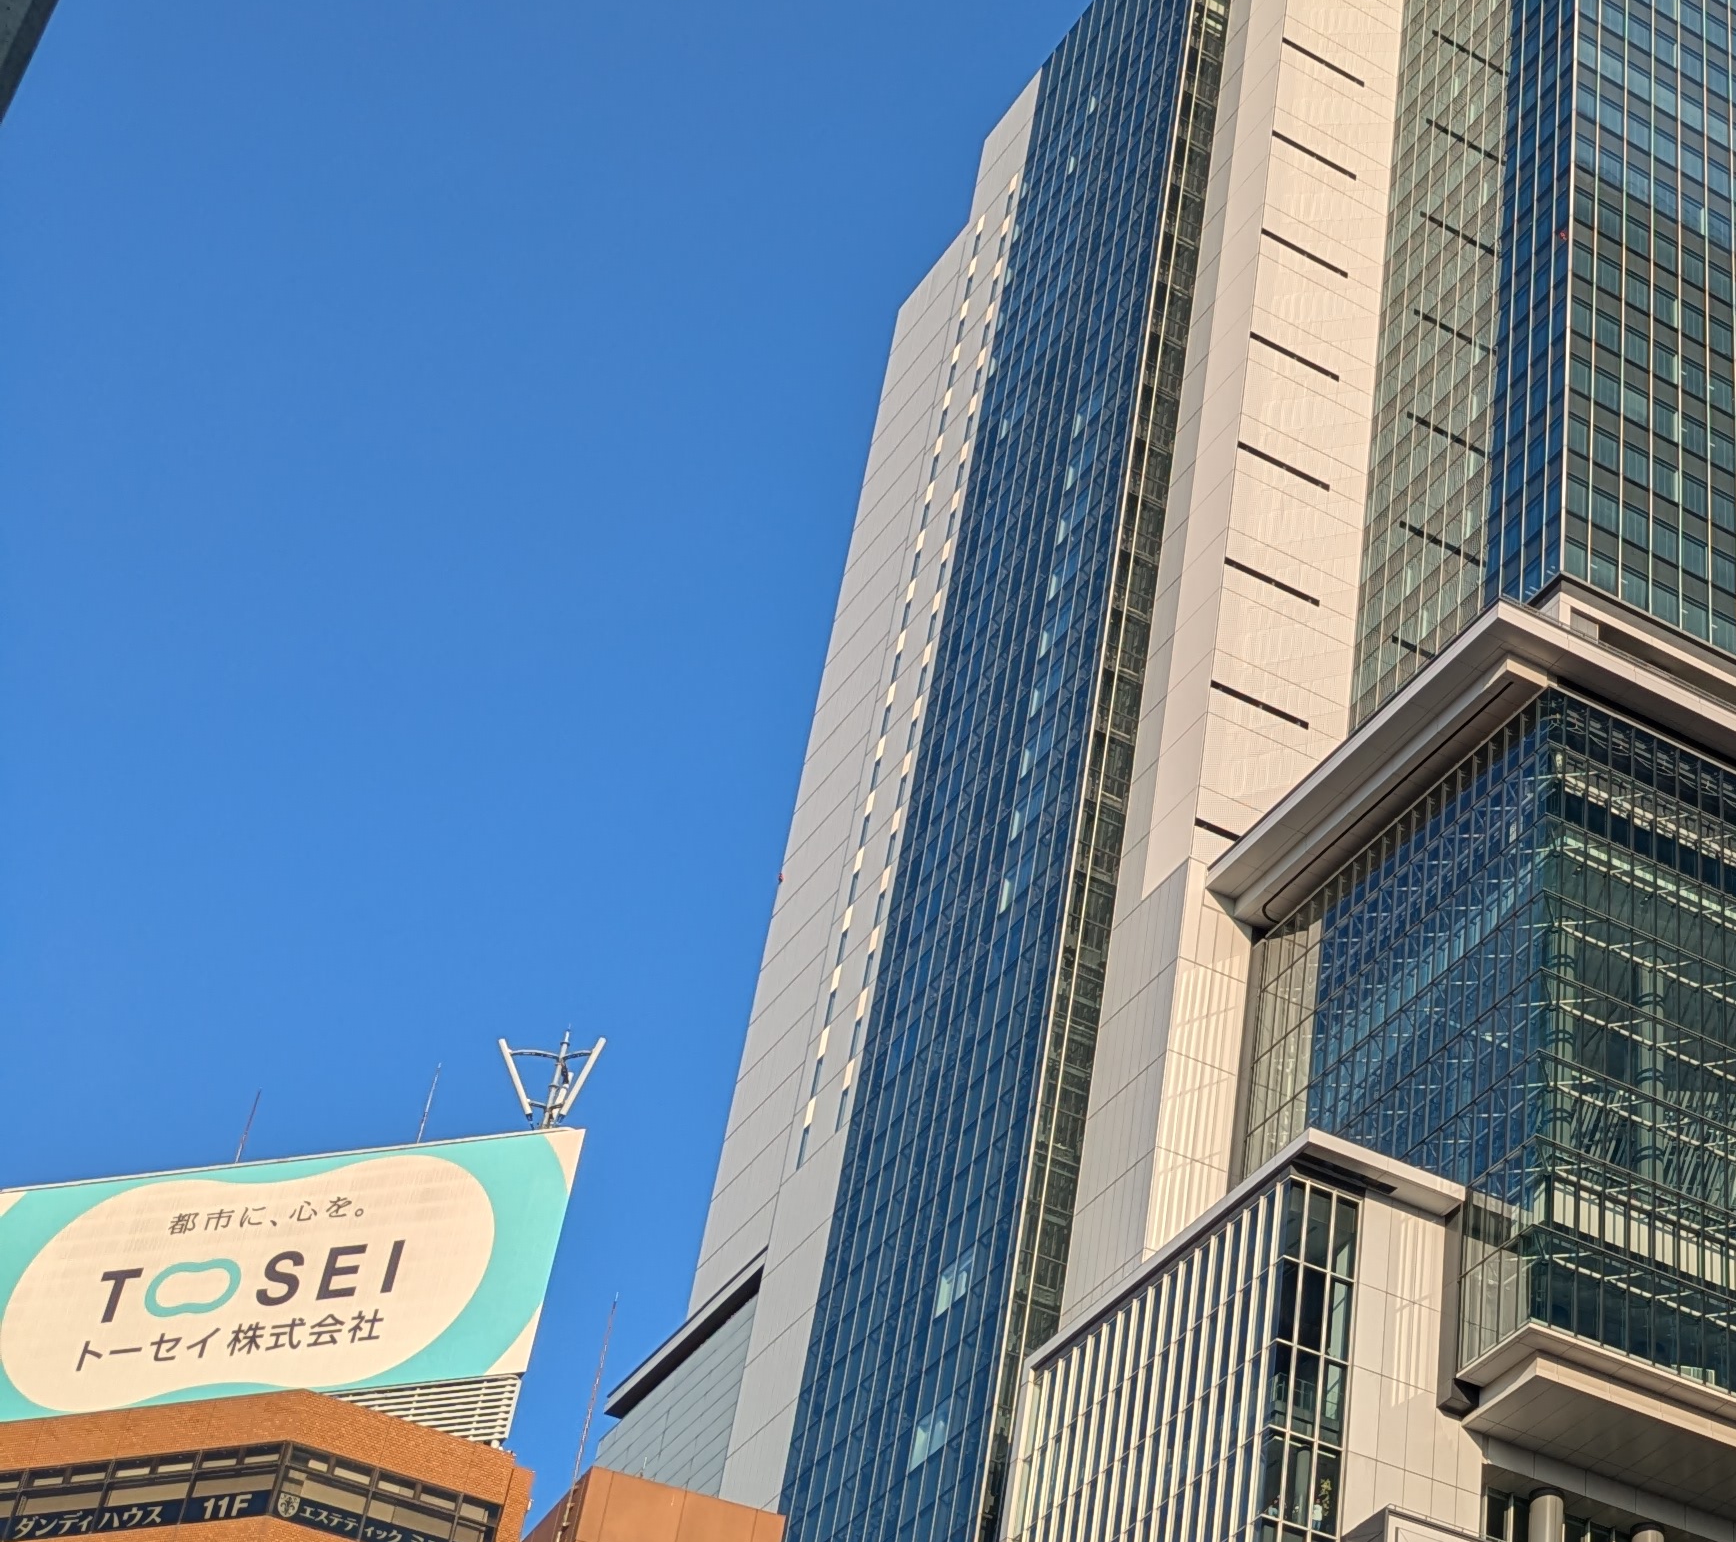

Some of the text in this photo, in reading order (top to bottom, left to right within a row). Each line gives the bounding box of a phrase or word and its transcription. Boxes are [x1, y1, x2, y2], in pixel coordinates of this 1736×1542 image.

[168, 1196, 365, 1236] 都市に、心を。
[75, 1309, 385, 1373] トーセイ株式会社
[203, 1493, 253, 1520] 11F
